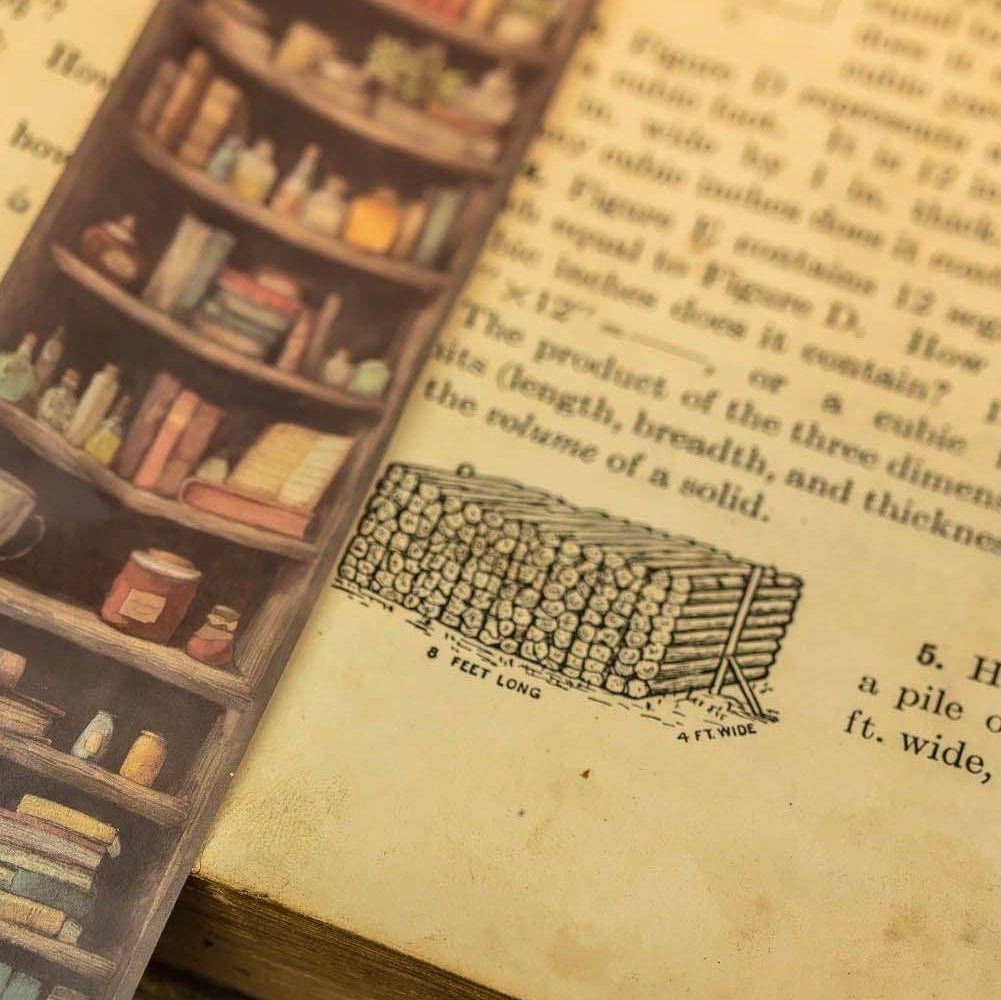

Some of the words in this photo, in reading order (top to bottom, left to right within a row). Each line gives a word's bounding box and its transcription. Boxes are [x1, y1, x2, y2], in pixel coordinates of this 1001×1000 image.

[701, 260, 812, 316] Figure
[554, 257, 658, 309] inches
[670, 298, 751, 340] does
[800, 345, 951, 403] contain?
[453, 295, 524, 345] The
[533, 339, 667, 400] product
[681, 389, 720, 414] of
[725, 400, 781, 435] the
[790, 422, 879, 468] three
[423, 377, 477, 416] the
[485, 408, 598, 463] volume
[606, 453, 646, 478] of
[648, 468, 669, 488] a
[679, 479, 769, 522] solid.
[496, 364, 623, 433] (length,
[633, 409, 775, 483] breadth,
[784, 469, 854, 505] and
[821, 394, 842, 415] a
[873, 411, 967, 455] cubic
[427, 646, 439, 660] 8
[451, 656, 490, 679] FEET
[496, 674, 542, 700] LONG
[916, 642, 944, 670] 5.
[857, 674, 880, 696] a
[892, 685, 964, 721] pile
[676, 731, 690, 744] 4
[717, 722, 757, 738] WIDE
[843, 709, 884, 743] ft.
[900, 732, 992, 785] wide,
